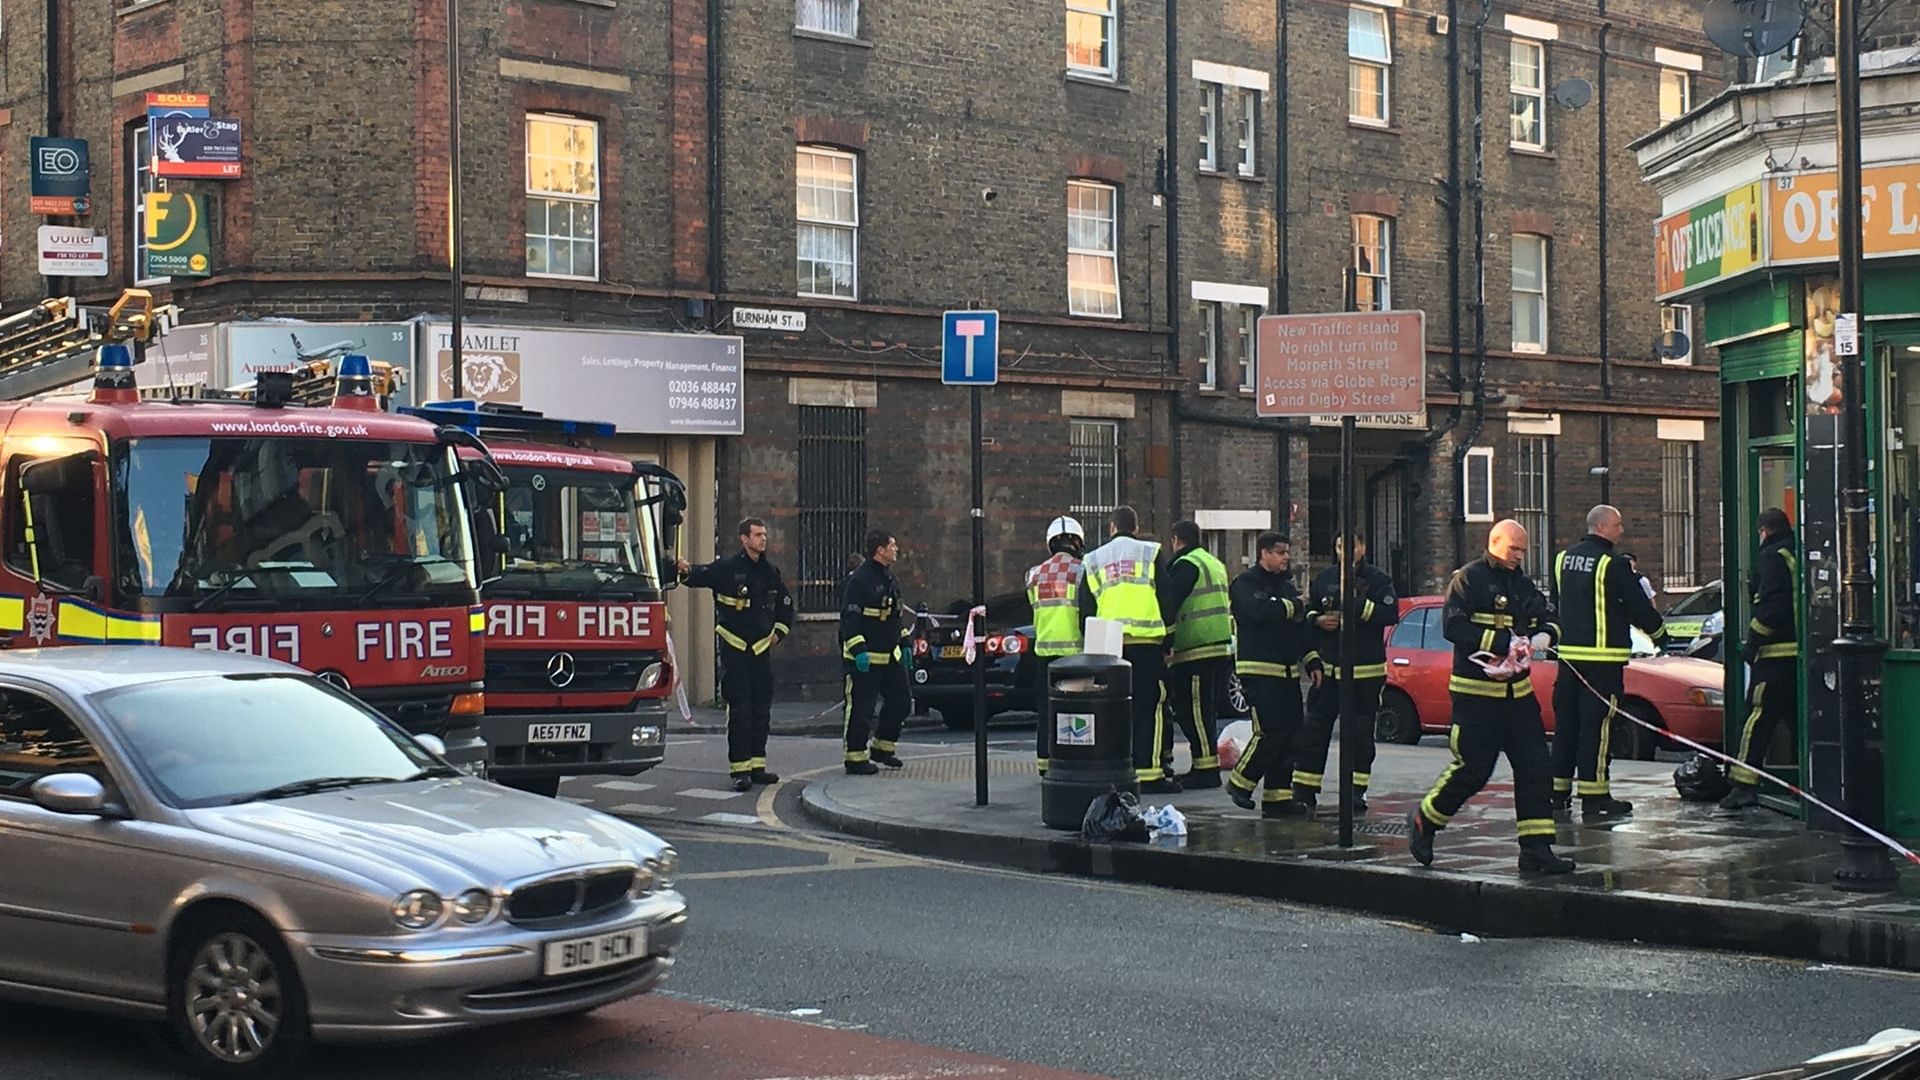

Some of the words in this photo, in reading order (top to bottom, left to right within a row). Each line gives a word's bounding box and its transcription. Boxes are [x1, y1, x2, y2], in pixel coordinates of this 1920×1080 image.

[157, 94, 197, 103] SOLD
[216, 121, 238, 131] Stag
[223, 165, 240, 174] LET
[1780, 177, 1791, 189] 37
[1888, 182, 1920, 235] L
[1672, 222, 1693, 274] OFF
[1695, 201, 1747, 265] LICENCE
[149, 254, 168, 263] 7704
[168, 255, 188, 263] 5000
[735, 311, 778, 325] BURNHAM
[392, 331, 404, 342] 35
[1278, 324, 1306, 337] New
[1310, 322, 1352, 336] Traffic
[1358, 321, 1400, 335] Island
[727, 345, 736, 355] 35
[1280, 341, 1299, 355] No
[1303, 339, 1333, 357] right
[1338, 340, 1367, 354] turn
[1371, 338, 1398, 352] into
[1840, 341, 1853, 354] 15
[634, 358, 664, 370] Property
[711, 362, 737, 373] Finance
[1287, 357, 1342, 374] Morpeth
[1346, 356, 1390, 371] Street
[668, 380, 699, 394] 02036
[700, 381, 737, 395] 488447
[1263, 376, 1306, 390] Access
[1311, 375, 1329, 389] via
[1334, 374, 1375, 389] Globe
[668, 396, 699, 410] 07946
[700, 397, 737, 411] 488437
[1280, 392, 1304, 407] and
[1310, 392, 1347, 409] Digby
[1351, 391, 1396, 406] Street
[1319, 414, 1372, 424] MUUM
[1374, 413, 1414, 425] HOUSE
[211, 420, 369, 437] www.london-fire.gov.uk
[1562, 554, 1596, 572] FIRE
[578, 605, 651, 637] FIRE
[356, 620, 452, 662] FIRE
[532, 725, 562, 740] AE57
[563, 724, 586, 739] FNZ
